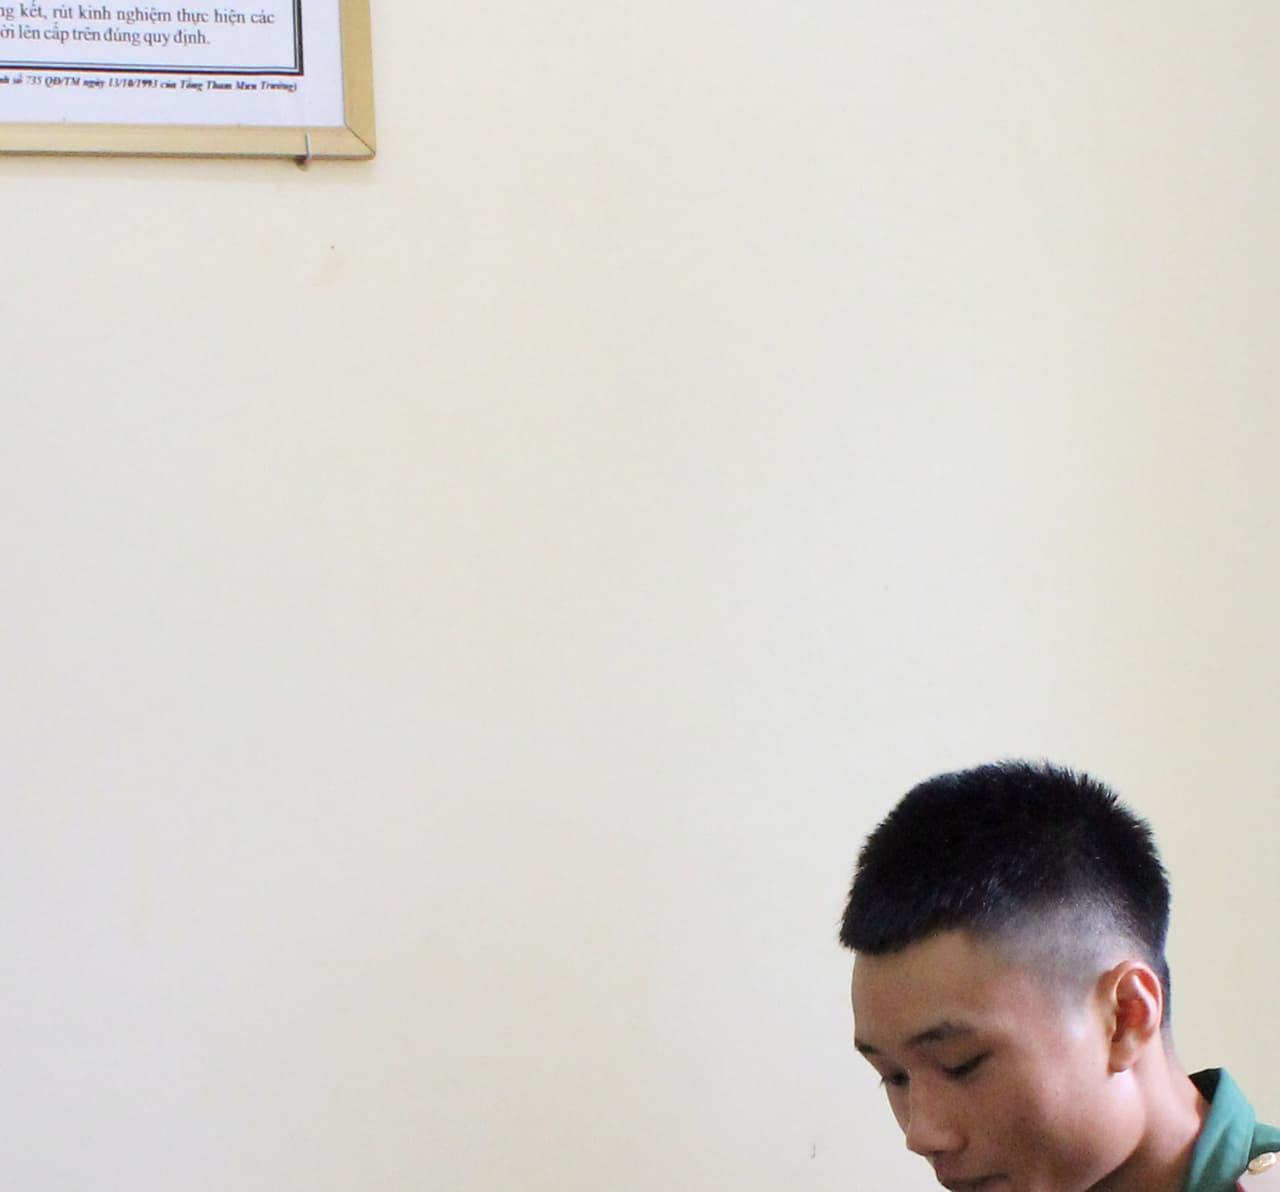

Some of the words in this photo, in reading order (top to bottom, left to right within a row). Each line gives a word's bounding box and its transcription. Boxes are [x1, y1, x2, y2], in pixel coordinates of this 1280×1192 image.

[53, 4, 72, 19] rút
[79, 5, 111, 20] kinh
[117, 7, 172, 24] nghiệm
[177, 8, 209, 25] thực
[214, 9, 244, 25] hiện
[251, 11, 275, 24] các
[19, 25, 41, 39] lên
[44, 21, 70, 44] cấp
[73, 27, 101, 41] trên
[104, 27, 140, 46] đúng
[144, 30, 170, 46] quy
[173, 29, 211, 47] định.
